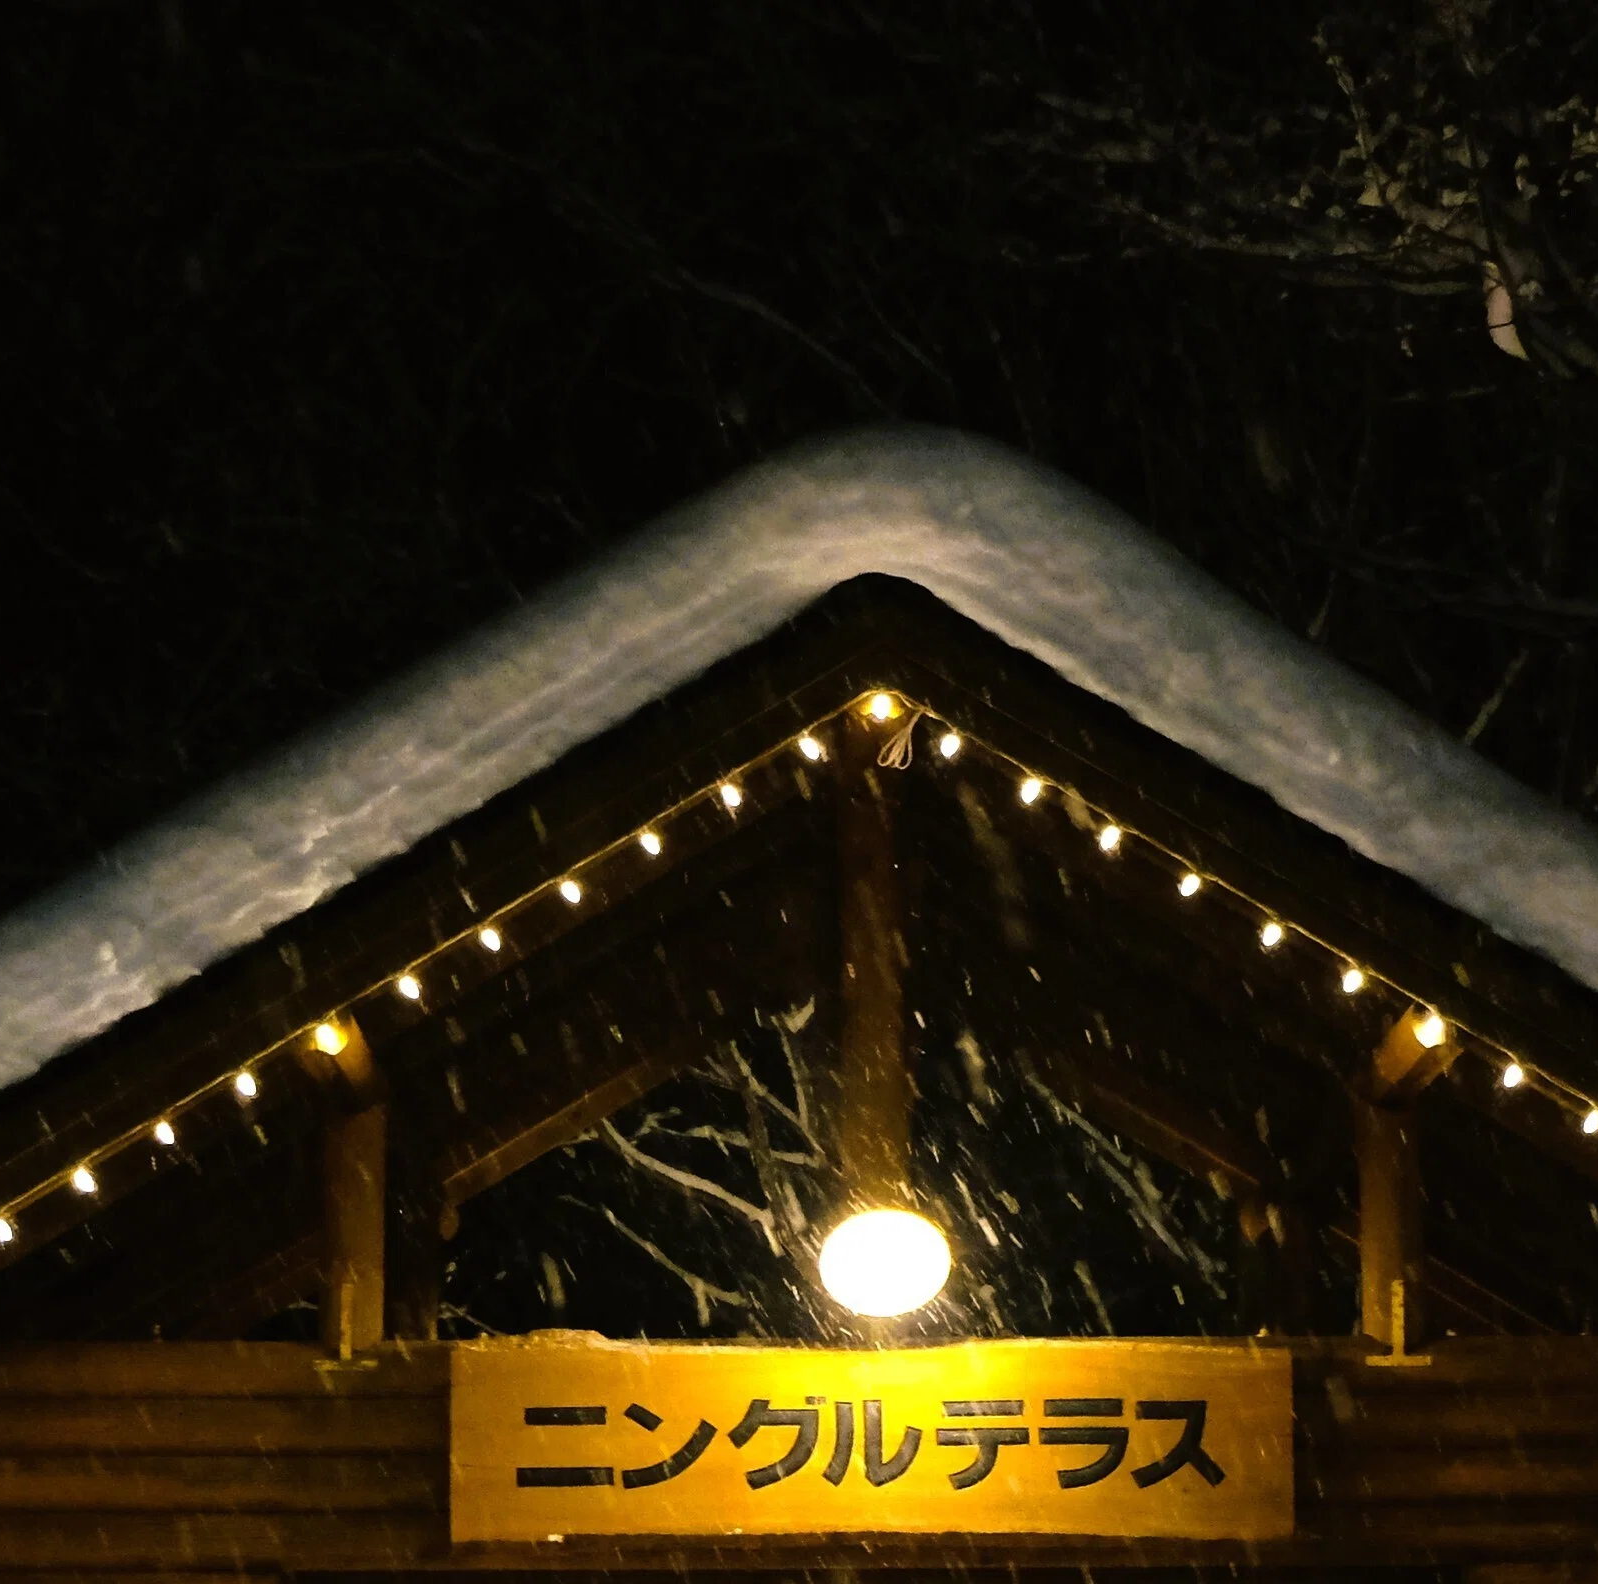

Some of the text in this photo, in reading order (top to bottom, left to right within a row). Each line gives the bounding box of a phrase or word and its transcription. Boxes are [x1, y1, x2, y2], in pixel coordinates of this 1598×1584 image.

[516, 1394, 1226, 1491] ニングルテラス
